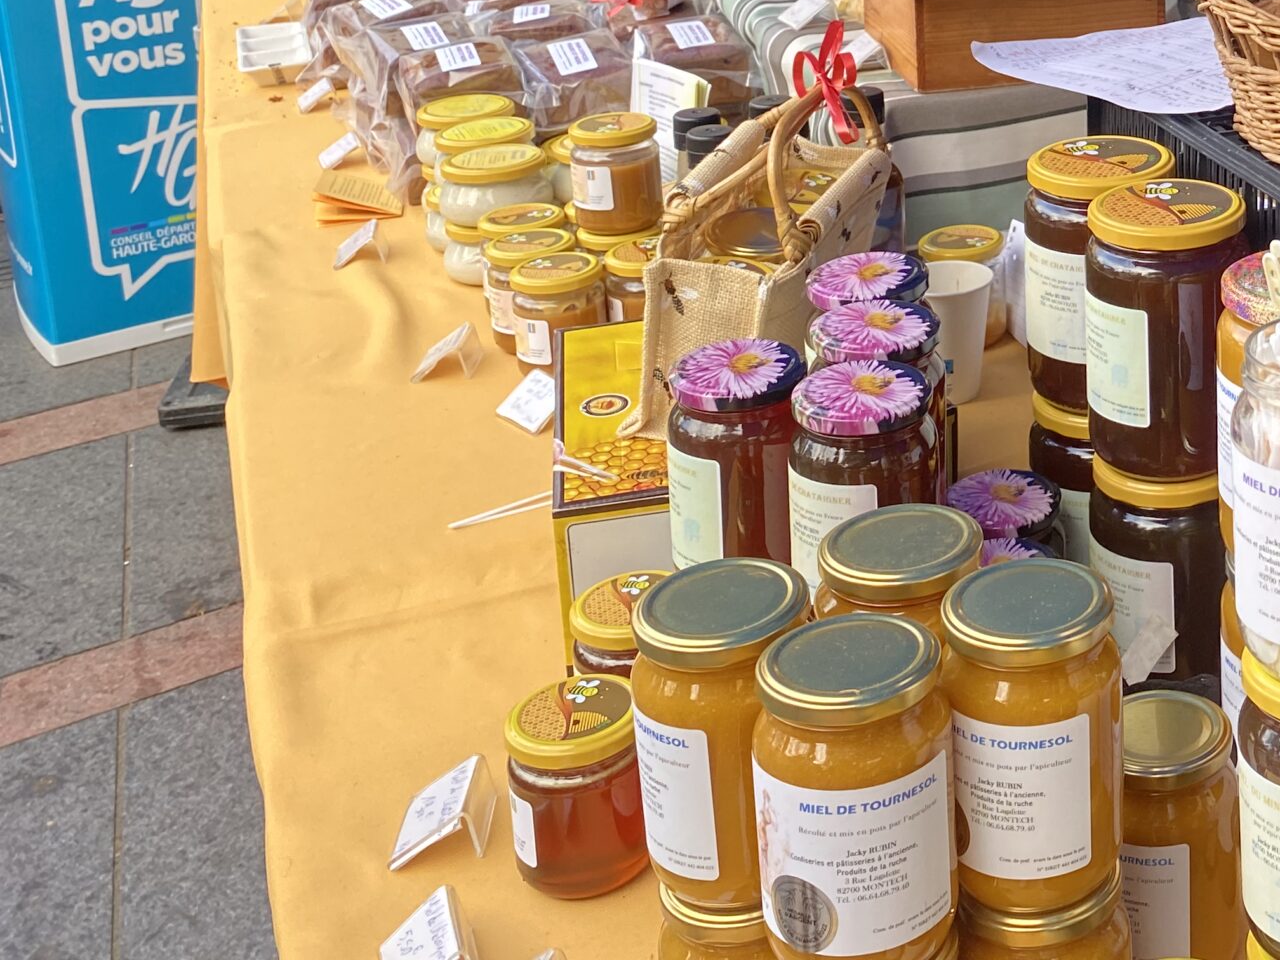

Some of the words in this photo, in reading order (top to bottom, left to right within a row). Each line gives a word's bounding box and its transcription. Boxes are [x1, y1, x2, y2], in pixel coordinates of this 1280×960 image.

[81, 9, 180, 51] pour
[86, 42, 186, 77] vous
[111, 231, 154, 247] CONSEIL
[156, 221, 196, 238] DÉPART
[112, 231, 196, 259] HAUTE-GARO
[1242, 472, 1266, 493] MIEL
[970, 733, 986, 746] DE
[989, 734, 1073, 750] TOURNESOL
[1015, 764, 1027, 772] par
[977, 777, 994, 787] Jacky
[996, 781, 1023, 790] RUBIN
[799, 802, 833, 815] MIEL
[836, 804, 857, 815] DE
[860, 773, 937, 812] TOURNESOL
[970, 791, 995, 804] Produits
[996, 797, 1004, 805] de
[1006, 798, 1012, 806] la
[990, 813, 1034, 824] MONTECH
[839, 829, 854, 837] mis
[856, 827, 867, 836] en
[869, 824, 887, 835] pots
[888, 819, 902, 830] par
[846, 847, 867, 859] Jacky
[869, 840, 897, 854] RUBIN
[790, 852, 825, 867] Confiseries
[836, 857, 875, 868] pâtisseries
[877, 853, 882, 862] à
[836, 866, 867, 876] Produits
[868, 864, 878, 873] de
[879, 861, 887, 870] la
[888, 855, 908, 868] ruche
[1120, 854, 1175, 866] URNESOL
[851, 875, 867, 885] Rue
[861, 872, 908, 893] MONTECH
